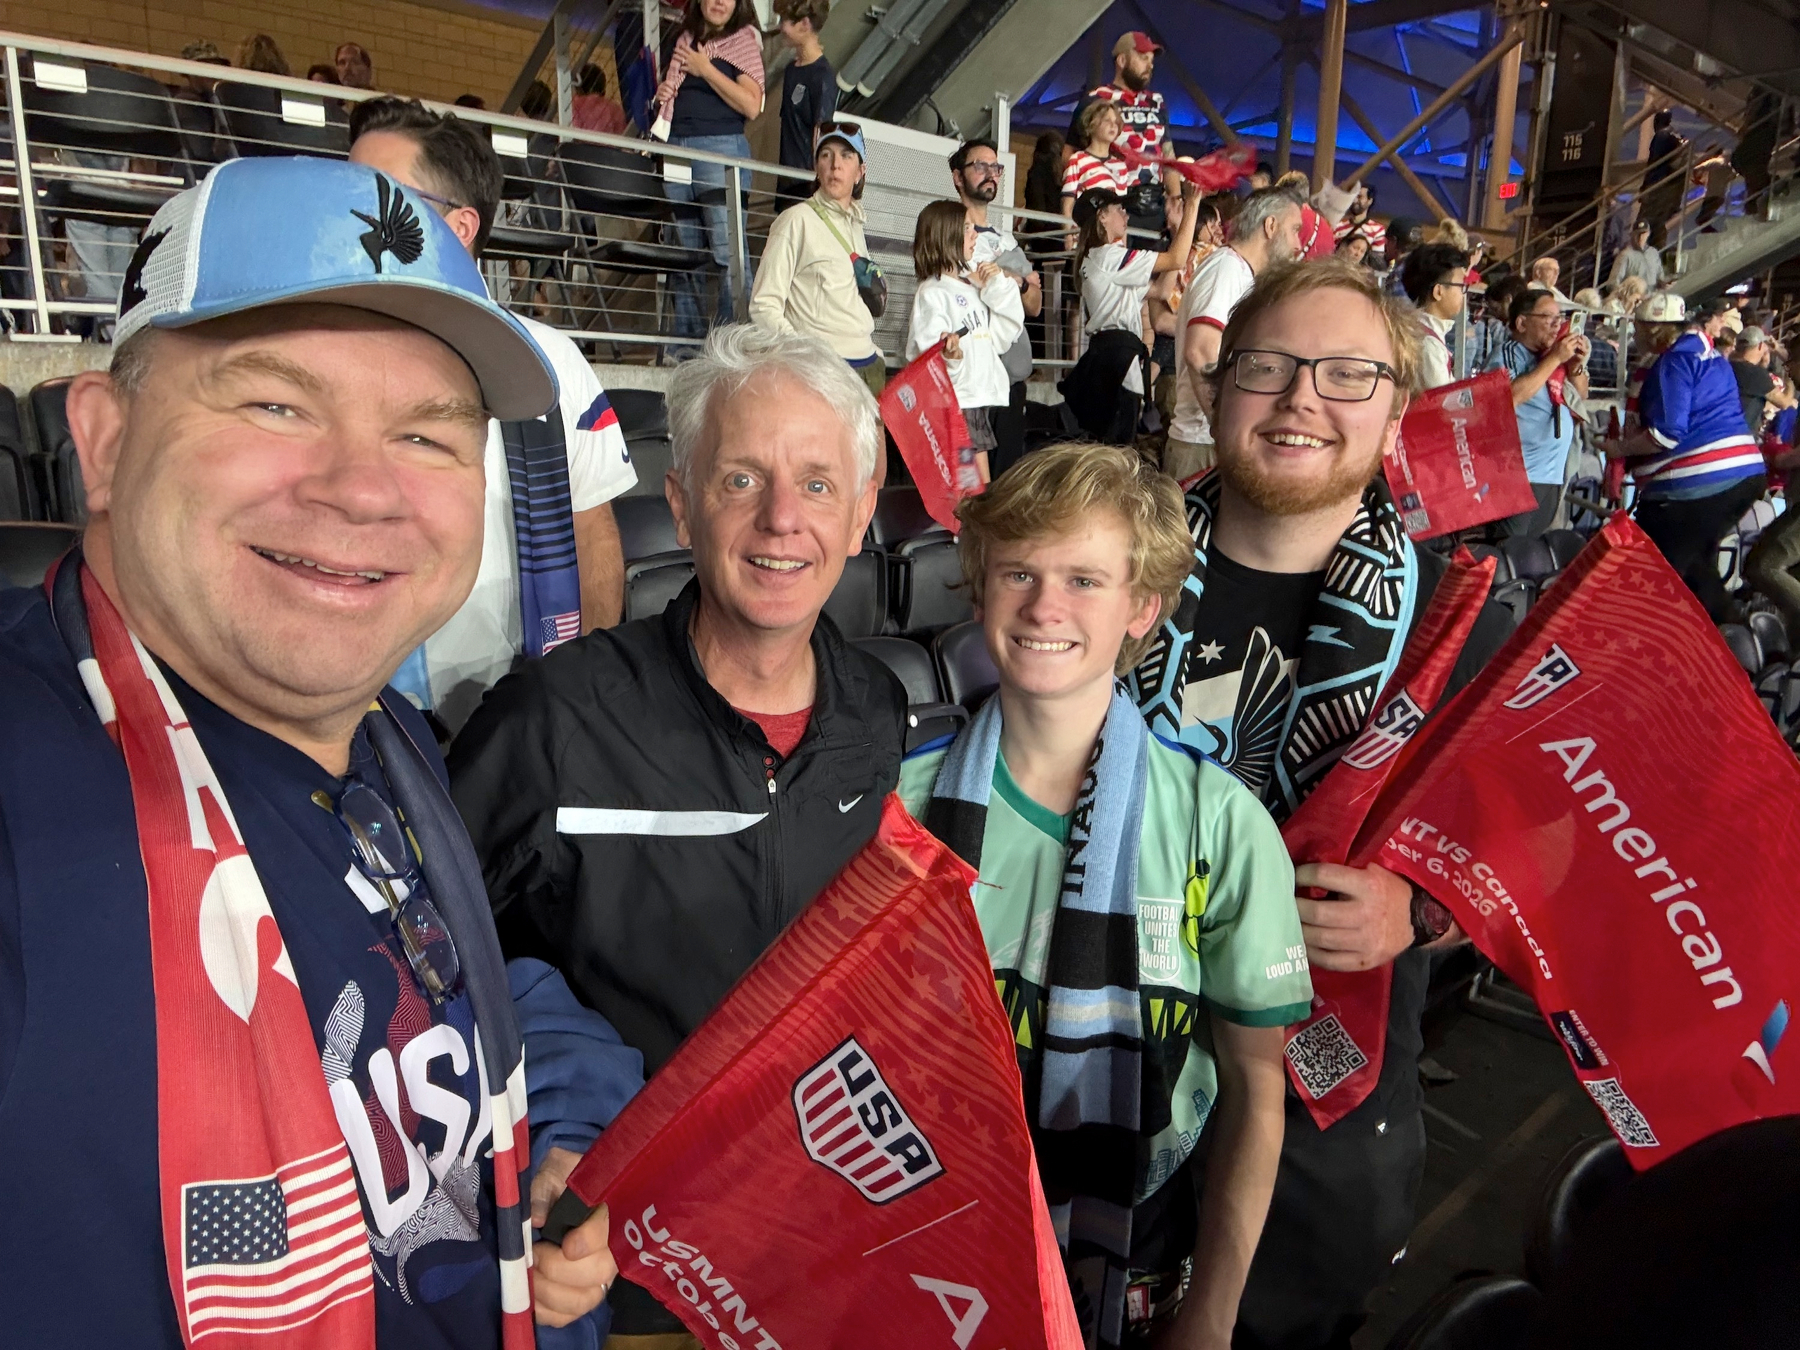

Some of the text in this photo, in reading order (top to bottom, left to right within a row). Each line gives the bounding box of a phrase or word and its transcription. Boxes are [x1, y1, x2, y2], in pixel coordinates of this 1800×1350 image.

[1121, 112, 1160, 124] USA
[1500, 183, 1517, 198] EXIT
[1451, 418, 1477, 489] American
[1426, 857, 1449, 880] 6,
[1452, 870, 1498, 917] 2026
[1538, 736, 1743, 1010] American
[1139, 904, 1178, 921] FOOTBAL
[1144, 921, 1177, 938] UNITES
[1471, 862, 1553, 980] Canada
[1143, 953, 1177, 970] WORLD
[1152, 938, 1171, 954] THE
[1285, 945, 1304, 960] WE
[1265, 961, 1293, 980] LOUD
[1569, 1010, 1589, 1036] ENTER
[1586, 1036, 1598, 1047] TO
[1595, 1047, 1609, 1066] WIN
[837, 1050, 932, 1175] USA
[624, 1220, 740, 1350] Octobe
[641, 1204, 782, 1350] USMNT
